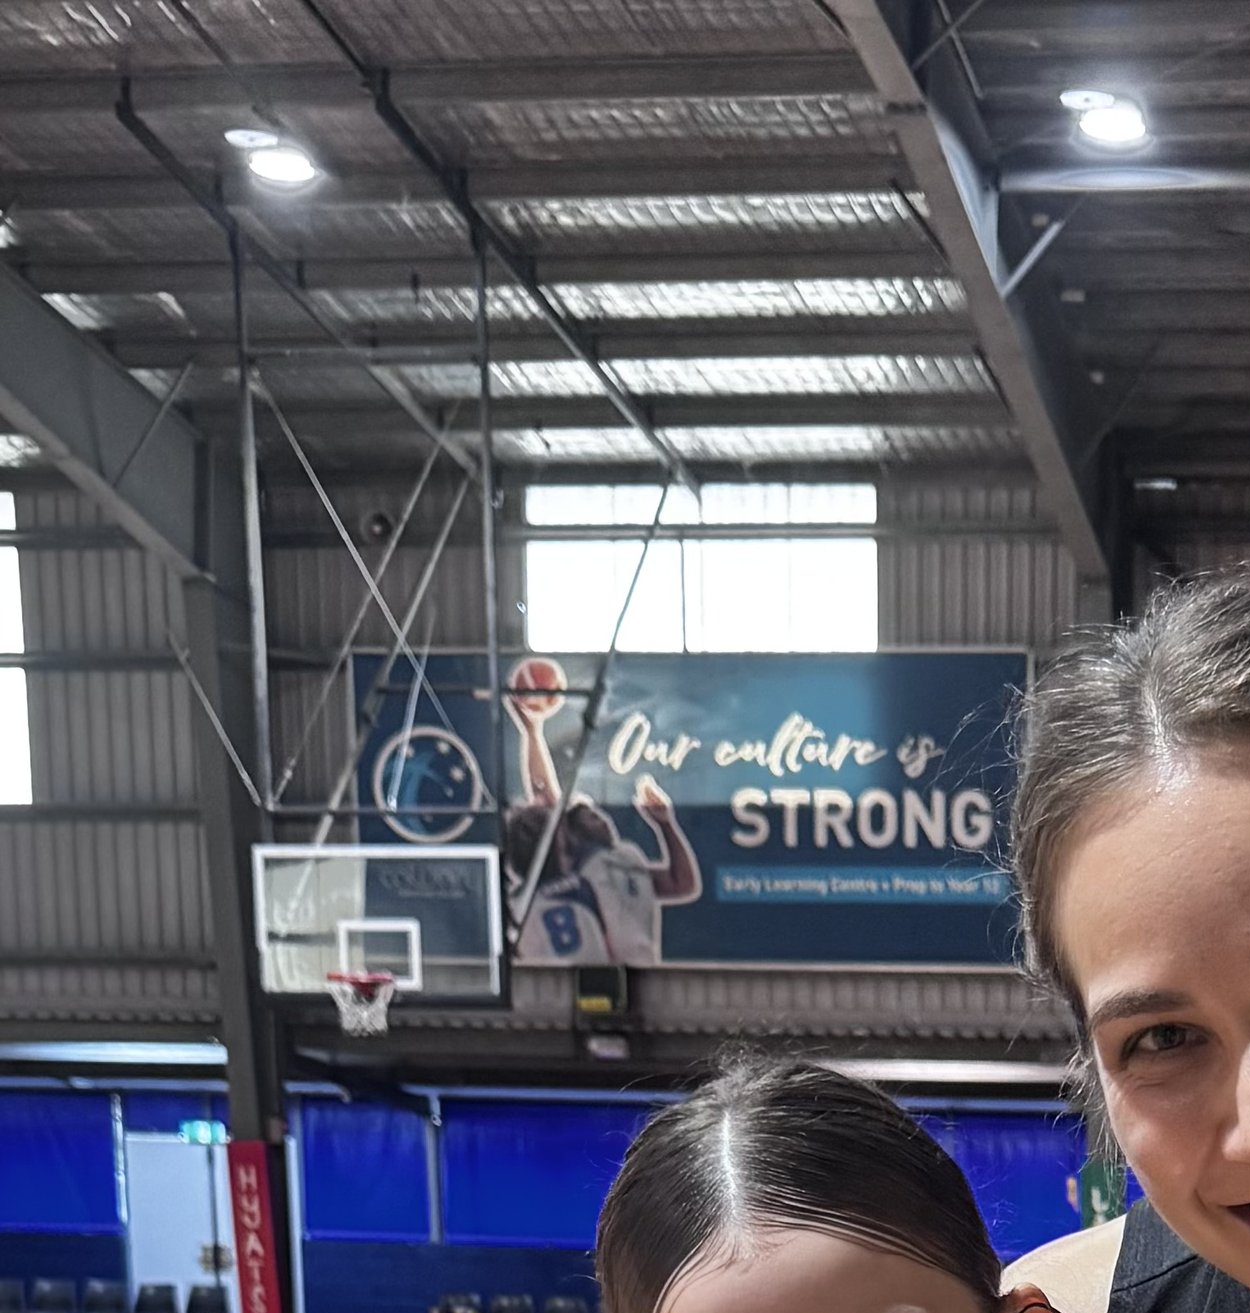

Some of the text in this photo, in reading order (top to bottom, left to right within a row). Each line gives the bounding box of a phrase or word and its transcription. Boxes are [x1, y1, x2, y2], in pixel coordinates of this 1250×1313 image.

[608, 711, 945, 778] Our culture is
[731, 787, 994, 849] STRONG
[542, 905, 583, 957] 8
